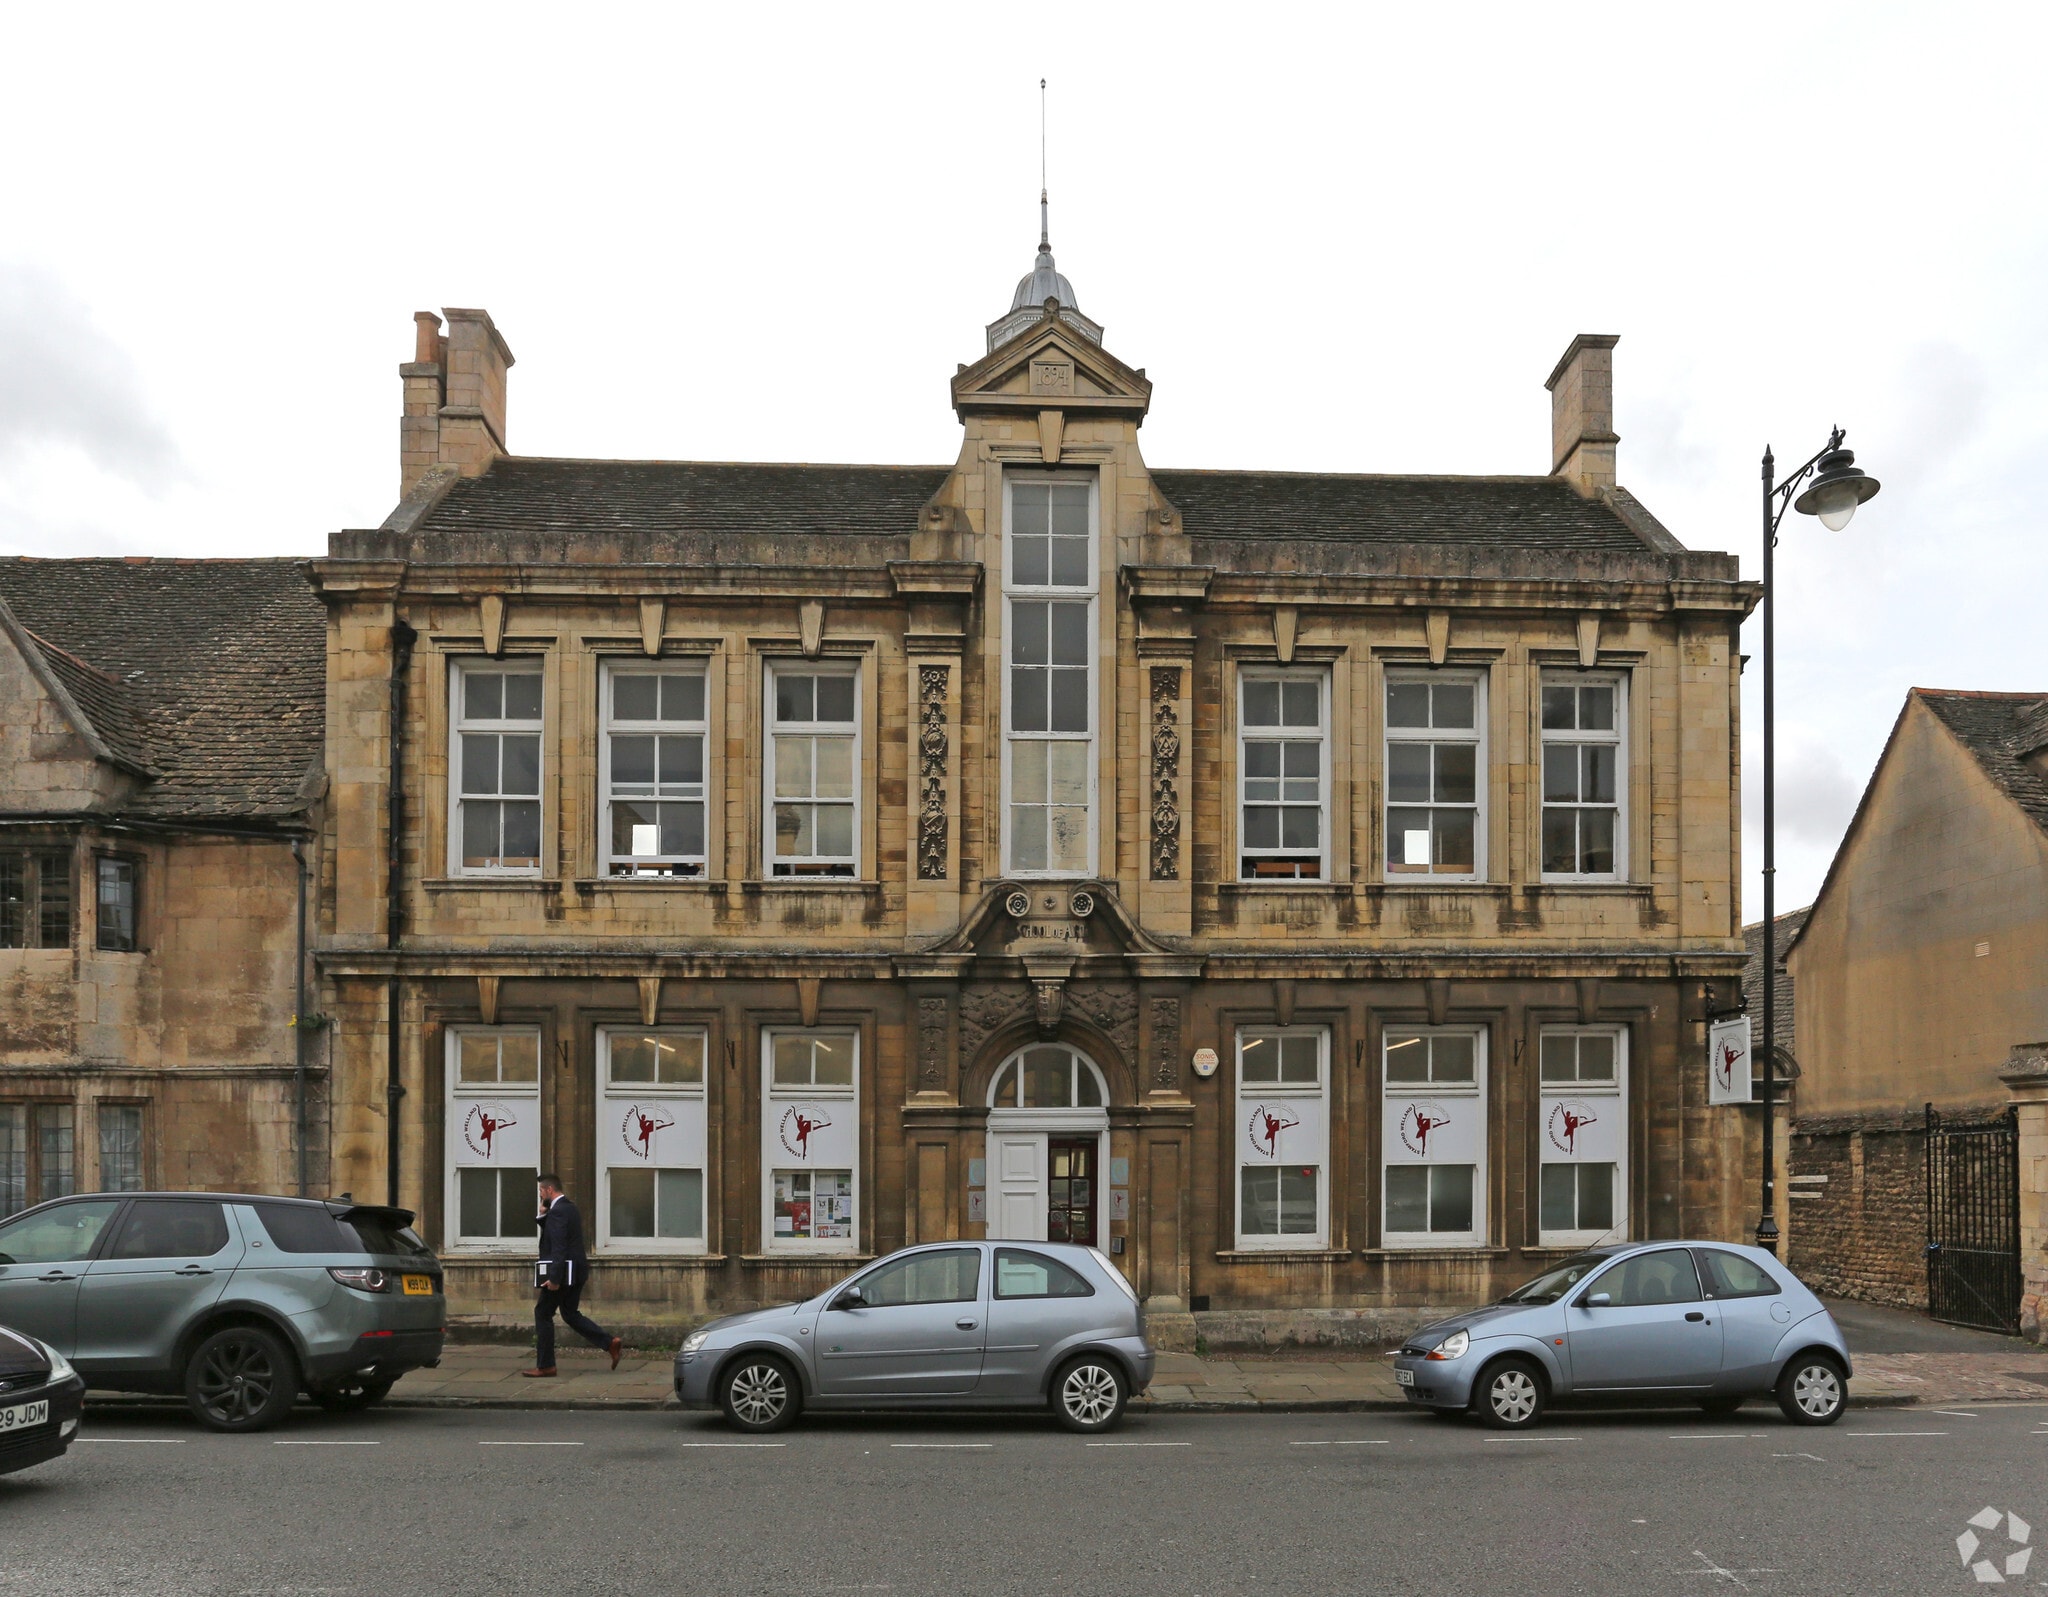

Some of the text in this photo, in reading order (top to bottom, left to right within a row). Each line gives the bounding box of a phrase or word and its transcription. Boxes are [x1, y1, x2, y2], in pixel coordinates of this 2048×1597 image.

[1036, 366, 1069, 387] 1894
[1016, 924, 1051, 938] SCHOOL
[464, 1107, 477, 1131] WELLAND
[622, 1108, 635, 1132] WELLAND
[780, 1108, 793, 1133] WELLAND
[1249, 1108, 1262, 1132] WELLAND
[1400, 1106, 1413, 1131] WELLAND
[1548, 1105, 1560, 1129] WELLAND
[19, 1402, 46, 1424] JDM
